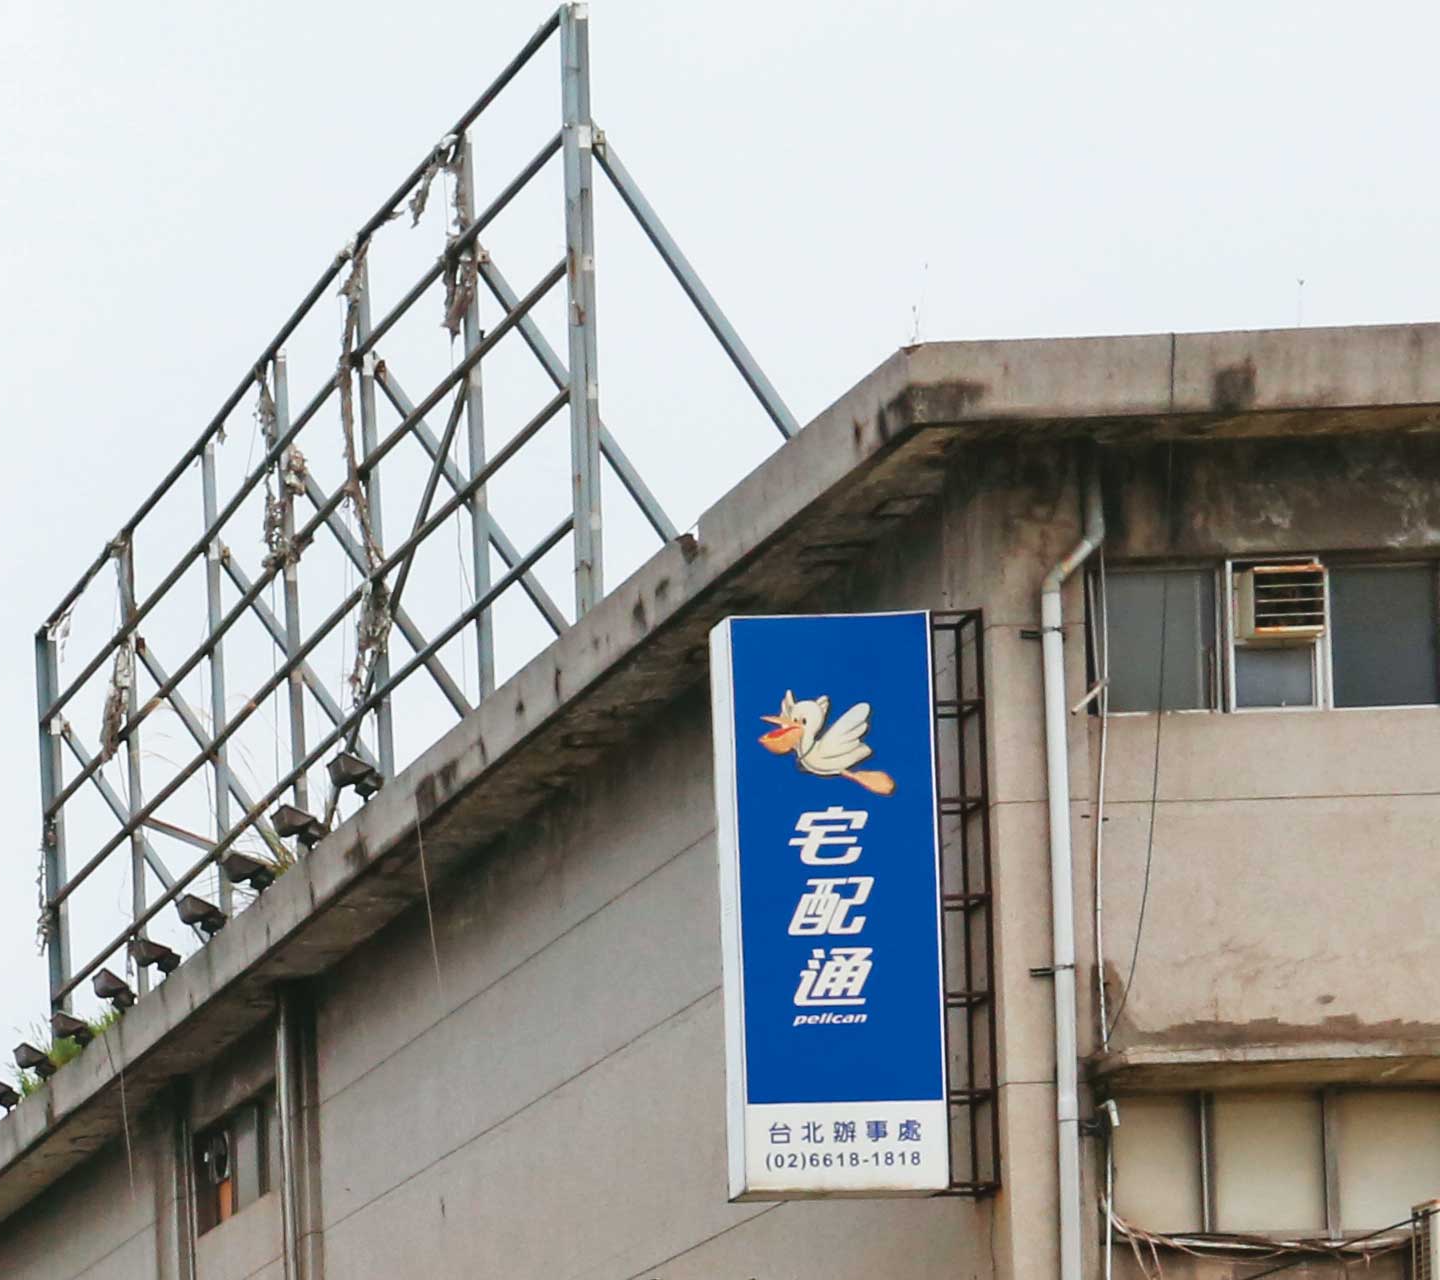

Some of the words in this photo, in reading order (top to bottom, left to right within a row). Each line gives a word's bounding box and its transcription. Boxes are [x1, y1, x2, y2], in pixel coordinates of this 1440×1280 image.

[788, 806, 874, 1006] 宅配通
[793, 1010, 867, 1027] pelican
[769, 1119, 922, 1145] 台北辦事處
[765, 1150, 922, 1171] (02)6618-1818
